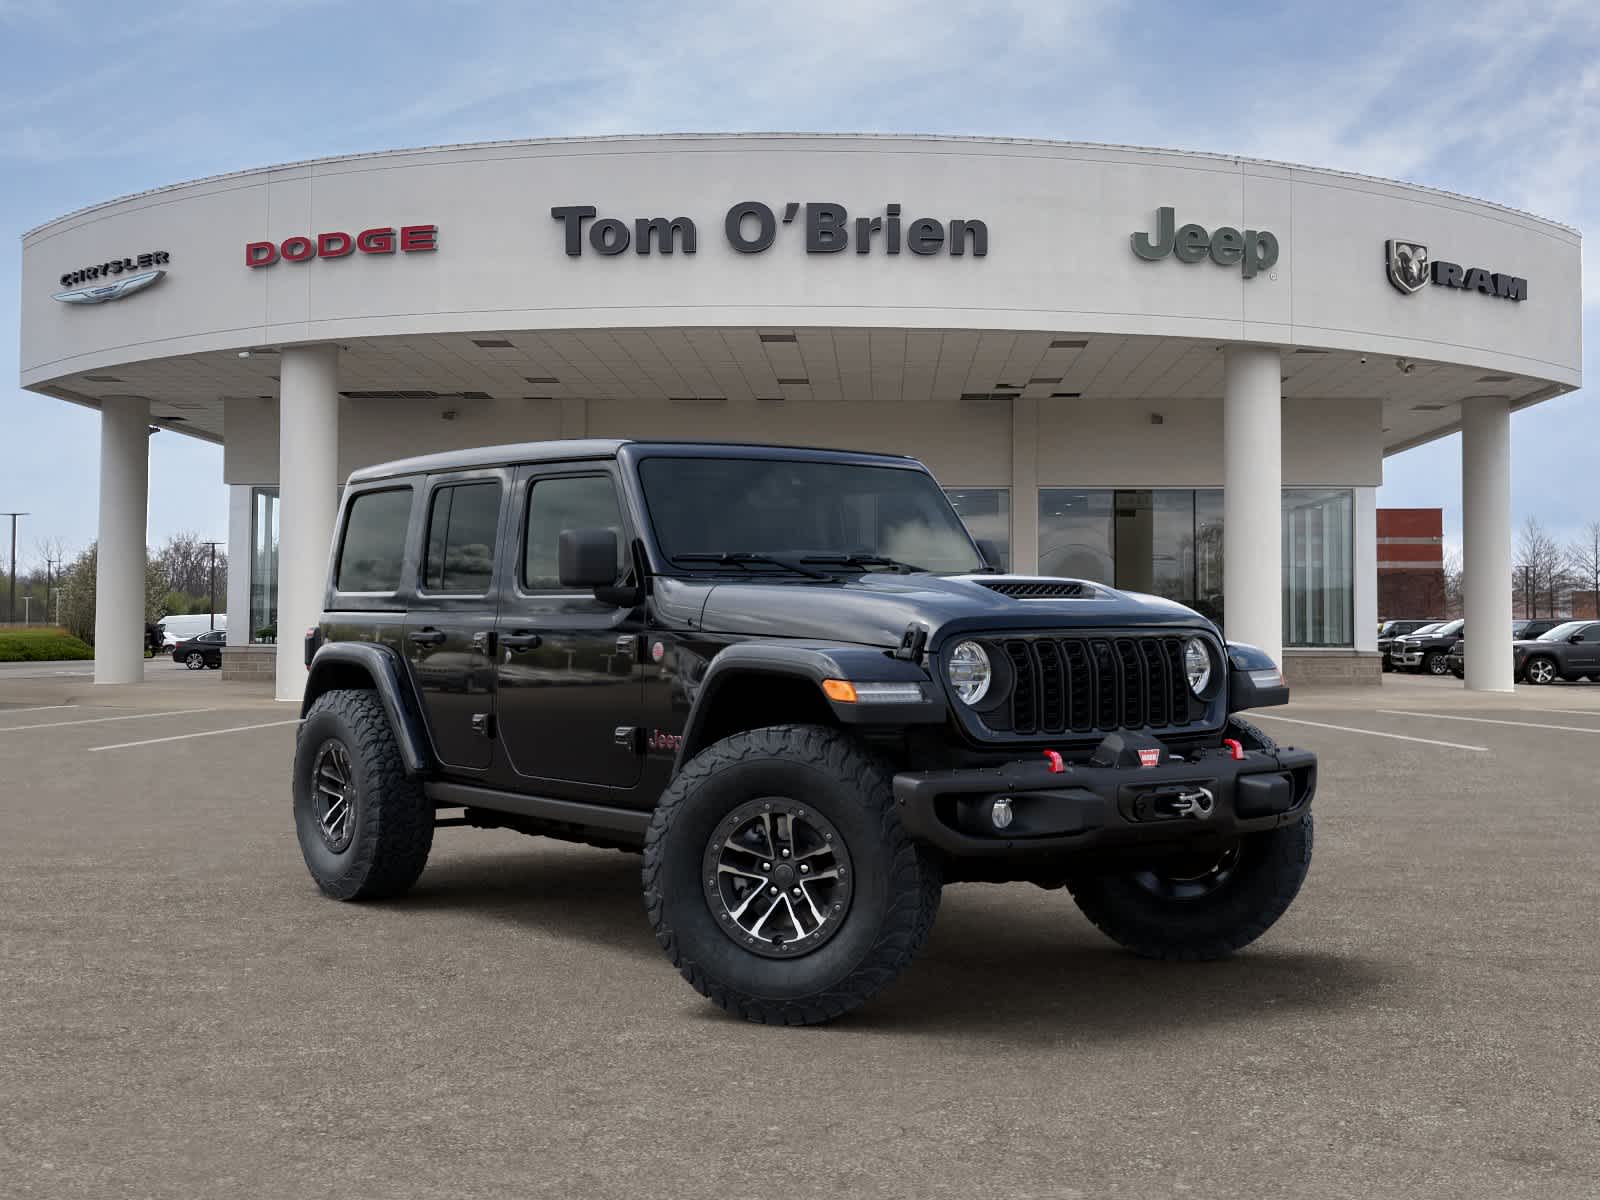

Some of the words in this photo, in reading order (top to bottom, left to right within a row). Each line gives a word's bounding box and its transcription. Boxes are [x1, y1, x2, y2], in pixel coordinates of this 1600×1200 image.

[246, 225, 438, 268] DODGE
[551, 205, 697, 256] Tom
[725, 201, 988, 256] O'Brien
[1130, 206, 1280, 279] Jeep
[60, 251, 169, 286] CHRYSLER
[1431, 261, 1528, 301] RAM
